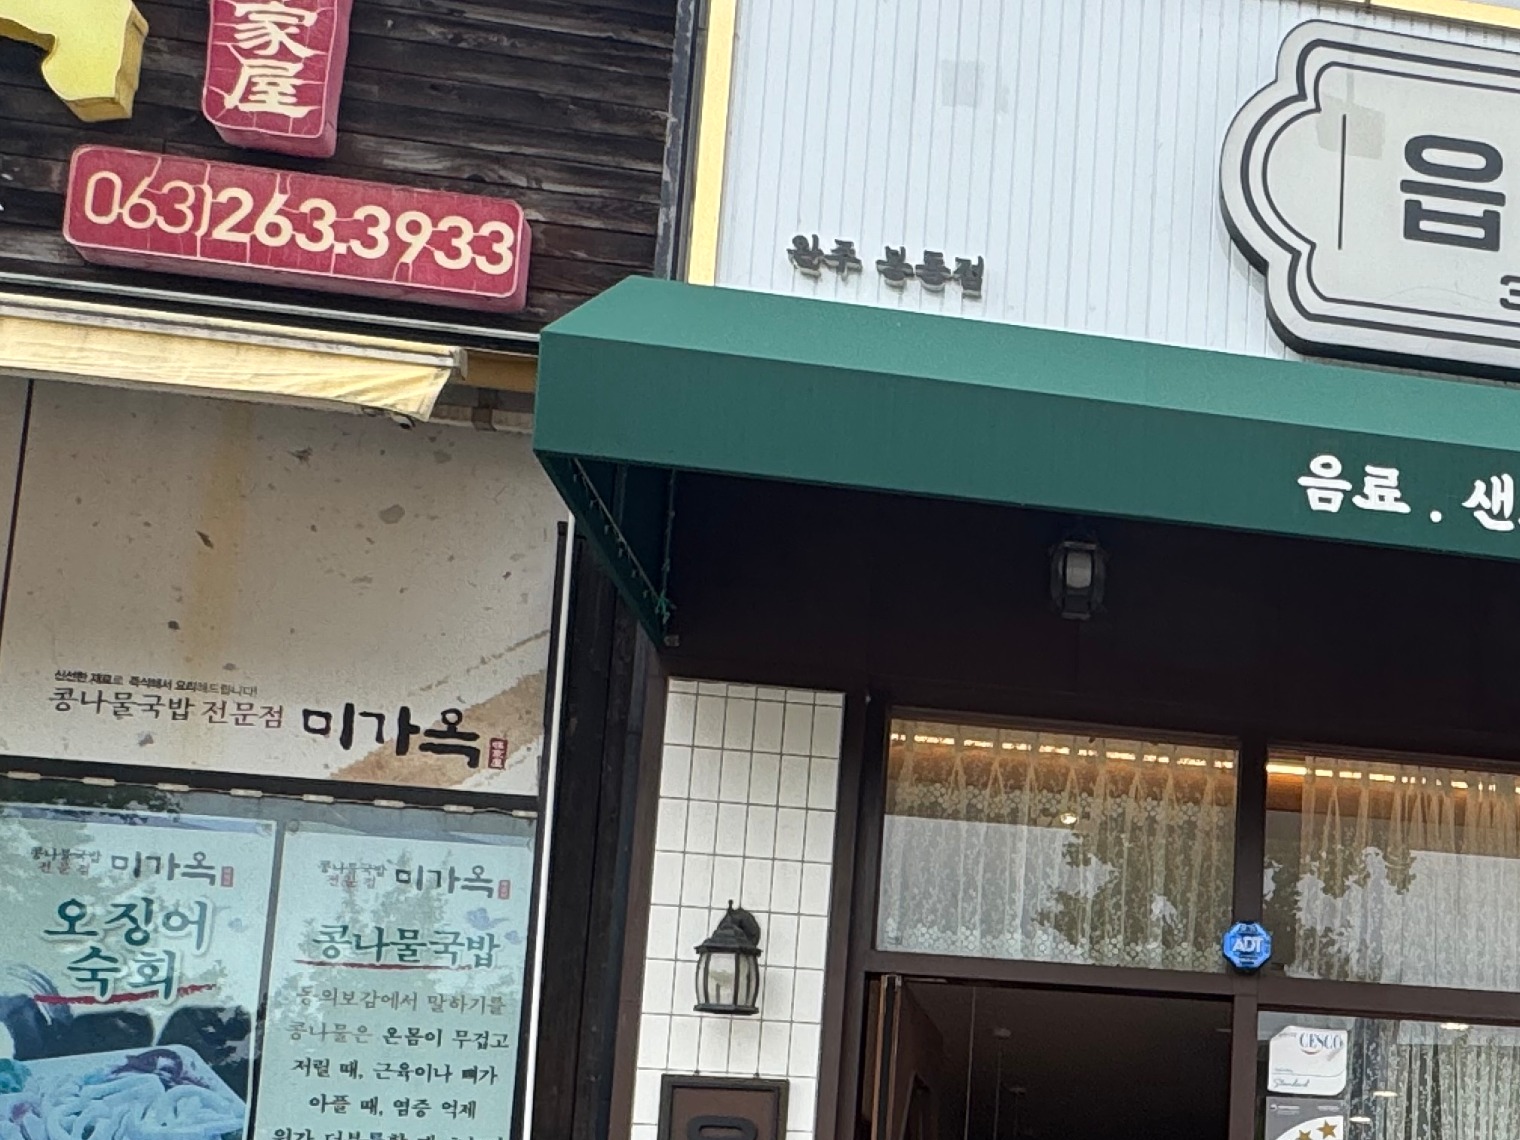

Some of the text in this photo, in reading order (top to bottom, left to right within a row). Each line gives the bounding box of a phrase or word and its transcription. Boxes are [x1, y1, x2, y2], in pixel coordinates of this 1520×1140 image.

[84, 169, 515, 275] 063)263.3933
[786, 233, 863, 278] 완주
[1297, 453, 1412, 514] 음료
[49, 686, 195, 721] 콩나물국밥
[201, 699, 284, 729] 전문점
[302, 702, 481, 769] 미가옥
[111, 851, 216, 886] 미가옥
[395, 864, 494, 899] 미가옥
[43, 896, 208, 950] 오징어
[312, 924, 501, 969] 콩나물국밥
[1232, 936, 1264, 953] ADT
[66, 945, 176, 1000] 숙회
[427, 992, 507, 1015] 말하기를
[286, 1021, 509, 1050] 콩나물은 온몸이 무겁고
[1299, 1032, 1344, 1050] CESCO
[373, 1061, 453, 1083] 근육이나
[309, 1093, 351, 1114] 아플
[393, 1098, 432, 1118] 염증
[441, 1099, 477, 1120] 억제
